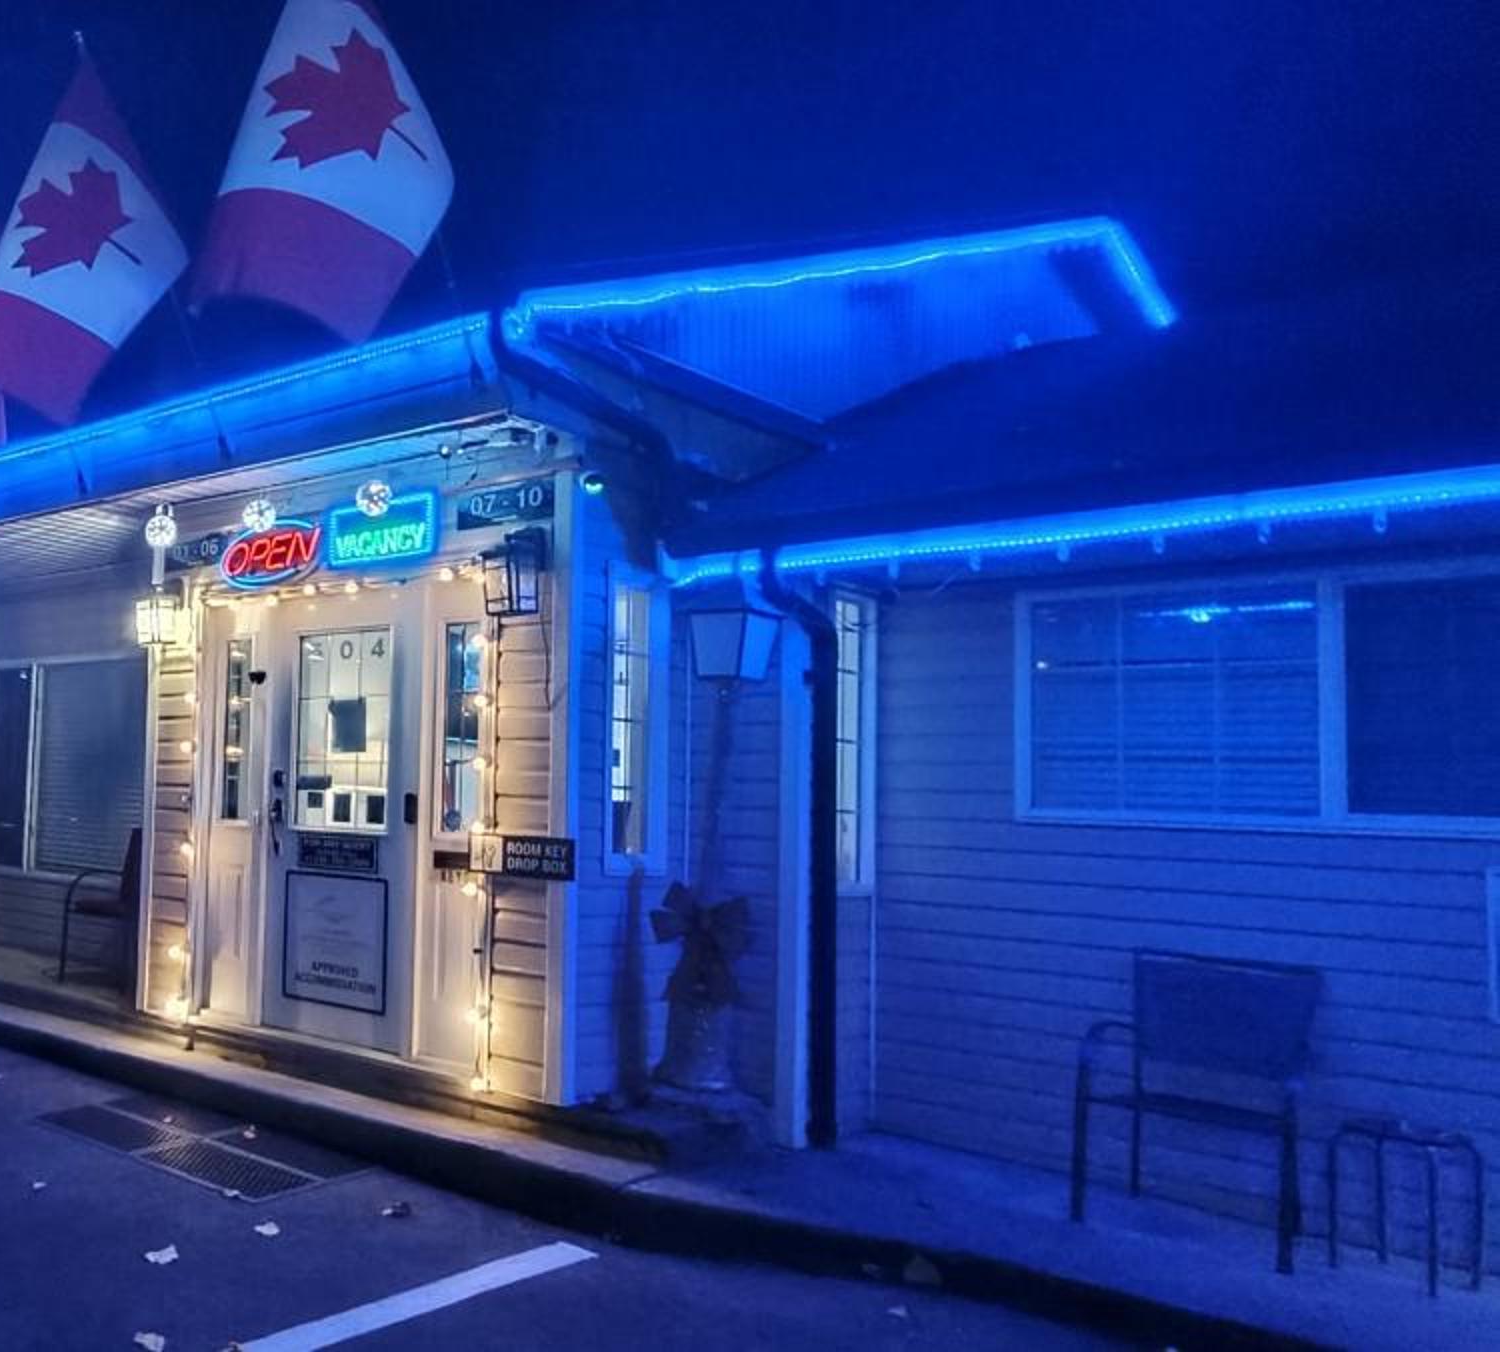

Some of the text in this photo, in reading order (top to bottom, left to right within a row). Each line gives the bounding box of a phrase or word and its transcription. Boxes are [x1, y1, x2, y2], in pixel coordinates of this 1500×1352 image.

[224, 526, 322, 577] OPEN
[335, 523, 426, 559] VACANCY
[507, 841, 566, 859] ROOM KEY
[507, 856, 566, 875] DROP BOX
